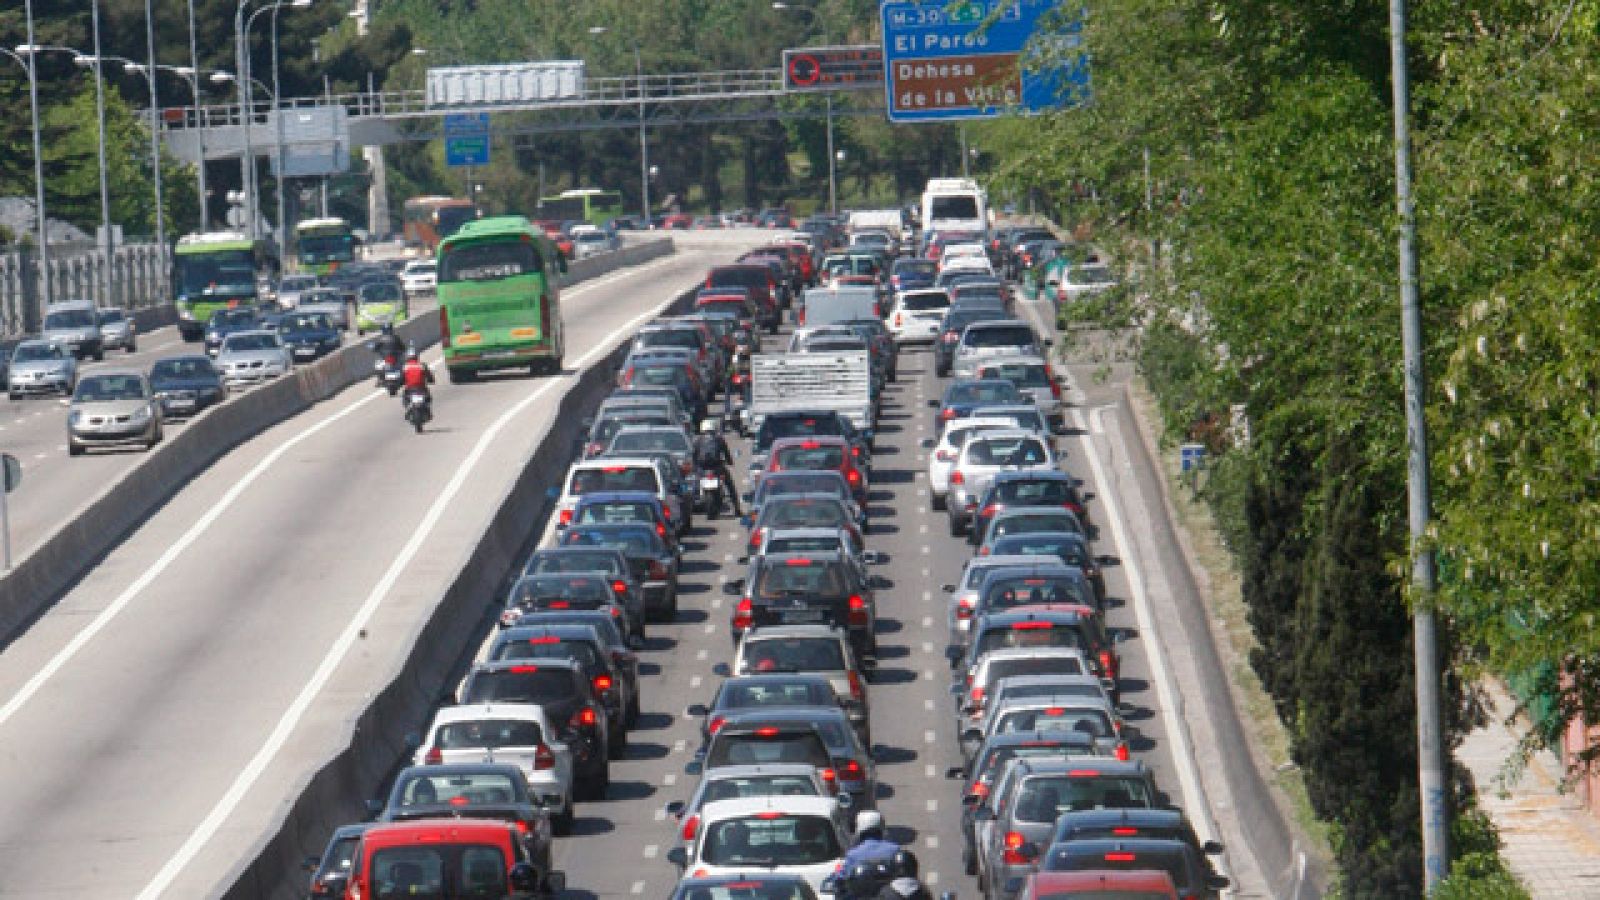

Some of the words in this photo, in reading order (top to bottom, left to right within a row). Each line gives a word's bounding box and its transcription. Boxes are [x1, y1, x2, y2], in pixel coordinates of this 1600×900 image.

[894, 34, 916, 52] El
[924, 33, 988, 50] Pardo
[899, 63, 975, 81] Dehesa
[900, 91, 926, 106] de
[935, 89, 956, 106] la
